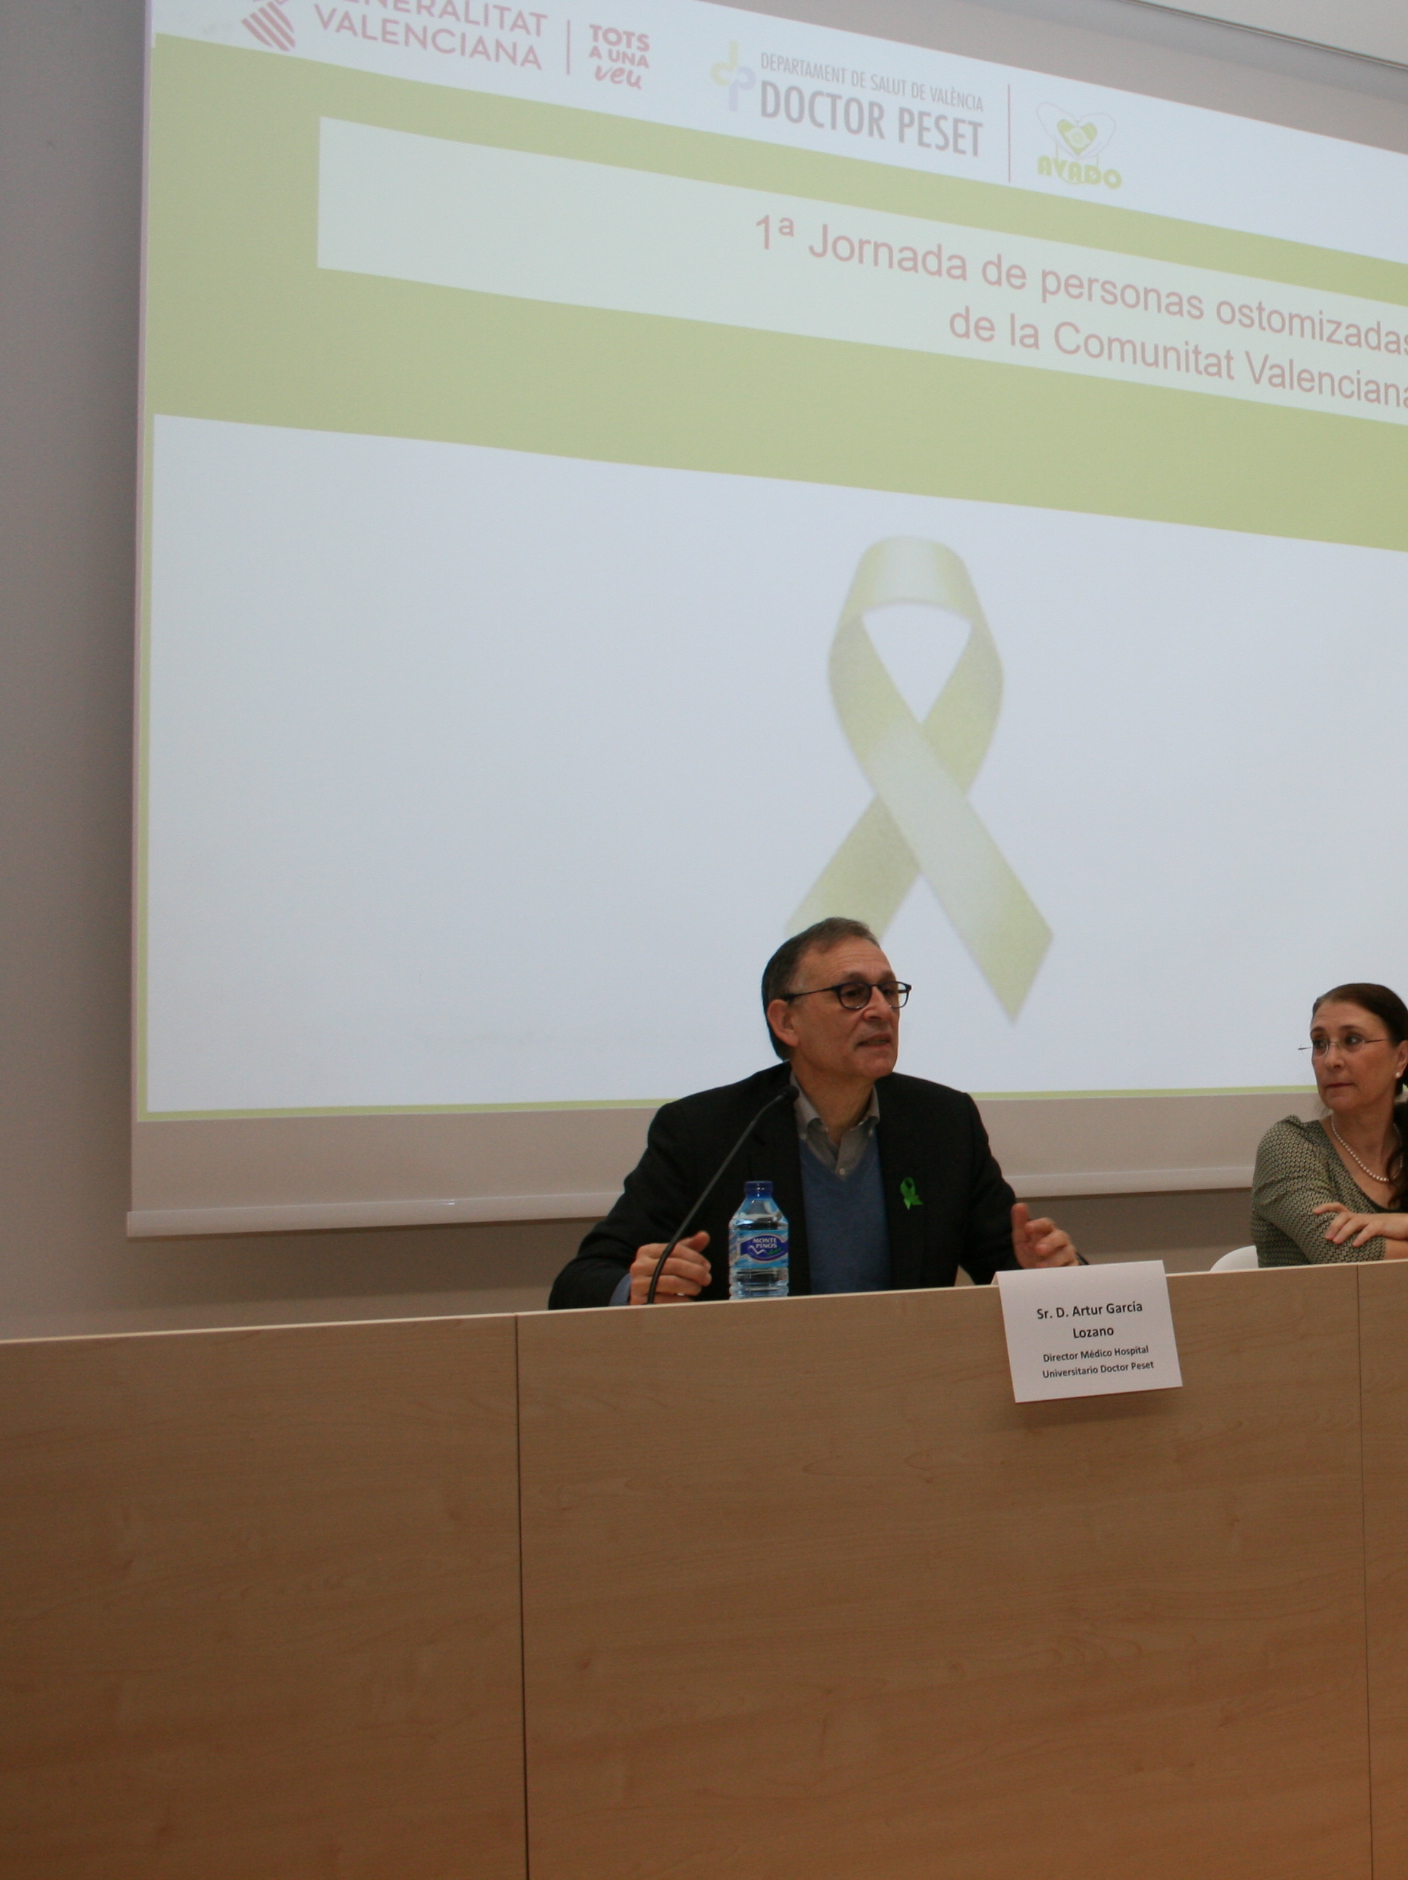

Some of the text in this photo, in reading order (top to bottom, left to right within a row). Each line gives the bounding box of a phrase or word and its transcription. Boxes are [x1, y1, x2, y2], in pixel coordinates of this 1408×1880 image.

[313, 3, 543, 70] VALENCIANA
[588, 24, 651, 52] TOTS
[588, 46, 650, 69] A UNA
[594, 64, 643, 90] veu
[760, 52, 984, 112] DEPARTAMENT DE SALUT DE VALÈNCIA
[760, 80, 984, 157] DOCTOR PESET
[755, 214, 795, 250] 1ª
[808, 223, 968, 281] Jornada
[981, 253, 1027, 291] de
[1041, 268, 1205, 321] personas
[949, 305, 996, 342] de
[1009, 312, 1040, 350] la
[1053, 321, 1236, 381] Comunitat
[1036, 1300, 1143, 1320] Sr. D. Artur García
[1072, 1325, 1114, 1339] Lozano
[1043, 1345, 1149, 1363] Director Médico Hospital
[1042, 1360, 1155, 1379] Universitario Doctor Peset
